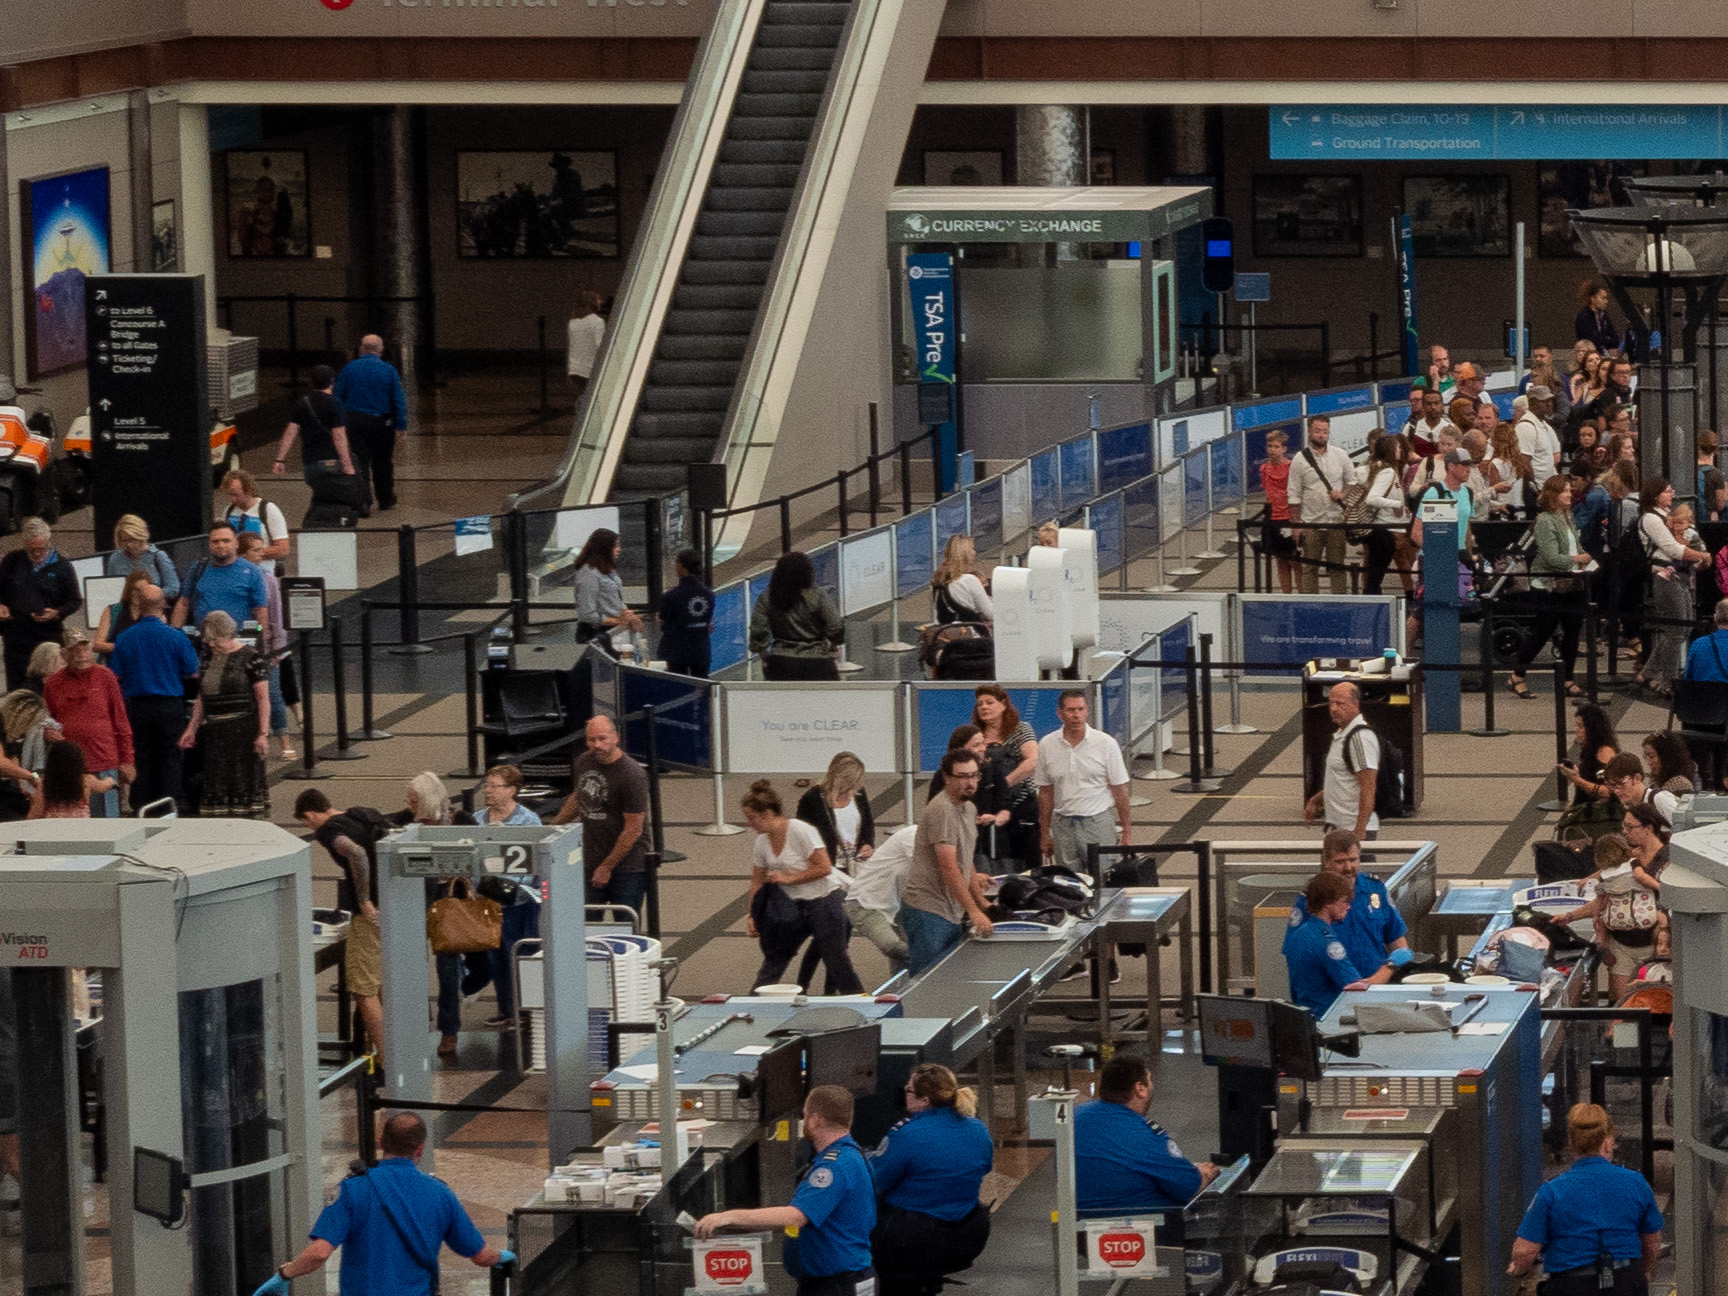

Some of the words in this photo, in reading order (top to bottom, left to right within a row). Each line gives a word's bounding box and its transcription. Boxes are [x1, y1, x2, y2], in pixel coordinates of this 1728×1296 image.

[1331, 113, 1387, 127] Baggage
[1433, 112, 1470, 125] 10-19
[1553, 112, 1634, 125] International
[1638, 112, 1687, 125] Arrivals
[1332, 136, 1380, 149] Ground
[1385, 137, 1480, 151] Transportation
[933, 220, 1015, 233] CURRENCY
[1020, 219, 1103, 233] EXCHANGE
[924, 291, 944, 327] TSA
[926, 333, 944, 363] Pre
[1341, 439, 1366, 449] CLEA
[762, 720, 784, 731] You
[788, 722, 809, 731] are
[505, 846, 528, 874] 2
[17, 947, 49, 959] ATD
[659, 1011, 668, 1031] 3
[1057, 1103, 1066, 1123] 4
[1104, 1240, 1141, 1254] STOP
[710, 1257, 748, 1271] STOP
